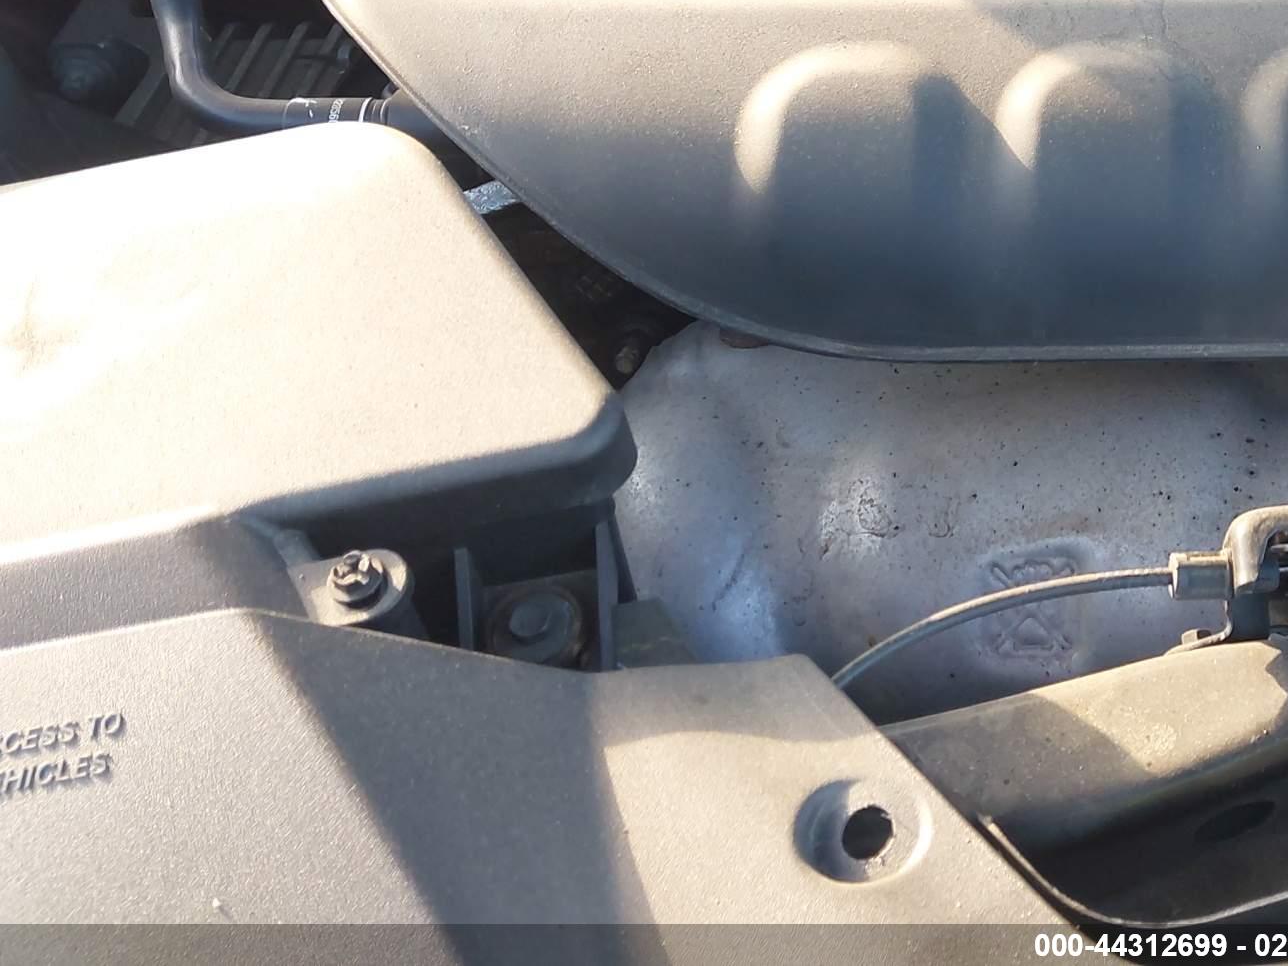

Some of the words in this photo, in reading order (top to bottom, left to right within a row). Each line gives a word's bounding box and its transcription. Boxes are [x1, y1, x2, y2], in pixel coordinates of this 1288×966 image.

[0, 721, 80, 755] CESS
[89, 712, 127, 740] TO
[0, 751, 113, 796] HICLES
